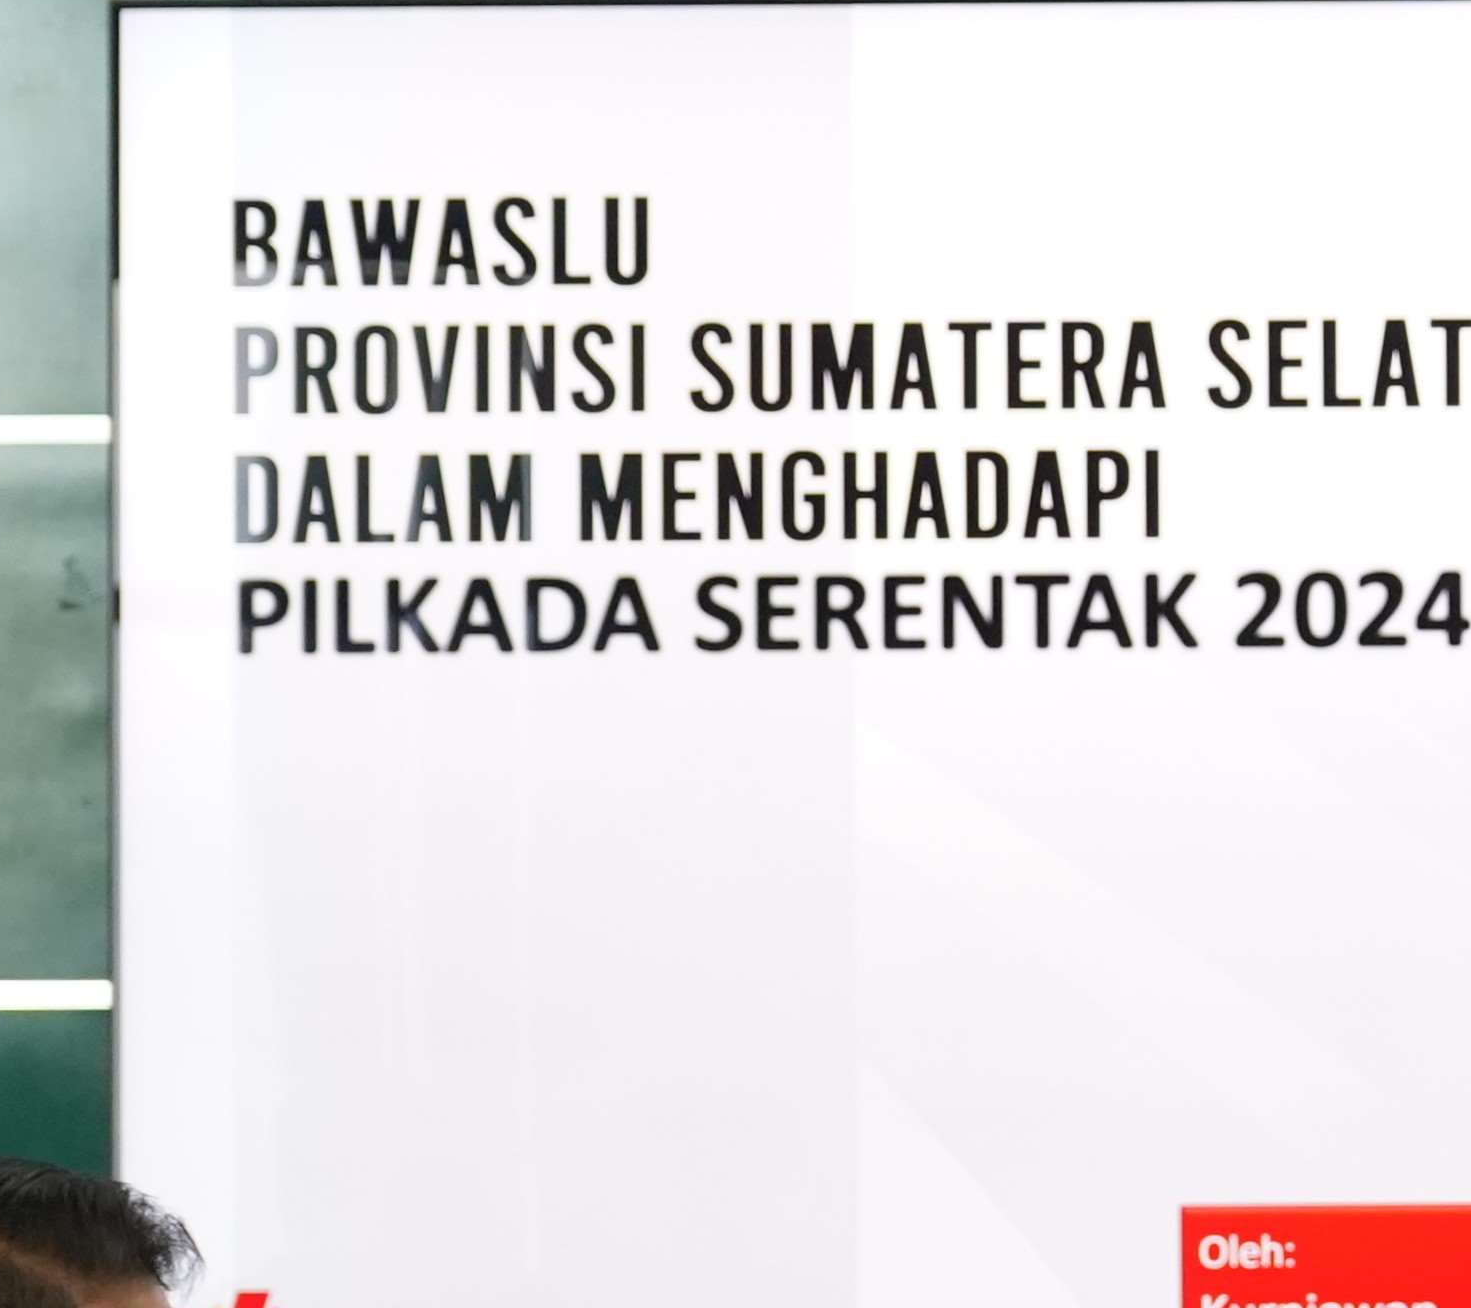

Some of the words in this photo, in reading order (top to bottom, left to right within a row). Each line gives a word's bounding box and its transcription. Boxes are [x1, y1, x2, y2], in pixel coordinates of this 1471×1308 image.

[233, 196, 648, 287] BAWASLU
[236, 323, 645, 415] PROVINSI
[690, 321, 1166, 412] SUMATERA
[236, 453, 532, 544] DALAM
[580, 450, 1159, 541] MENGHADAPI
[238, 576, 660, 654] PILKADA
[695, 573, 1198, 652] SERENTAK
[1235, 571, 1470, 648] 2024
[1199, 1234, 1295, 1269] Oleh:
